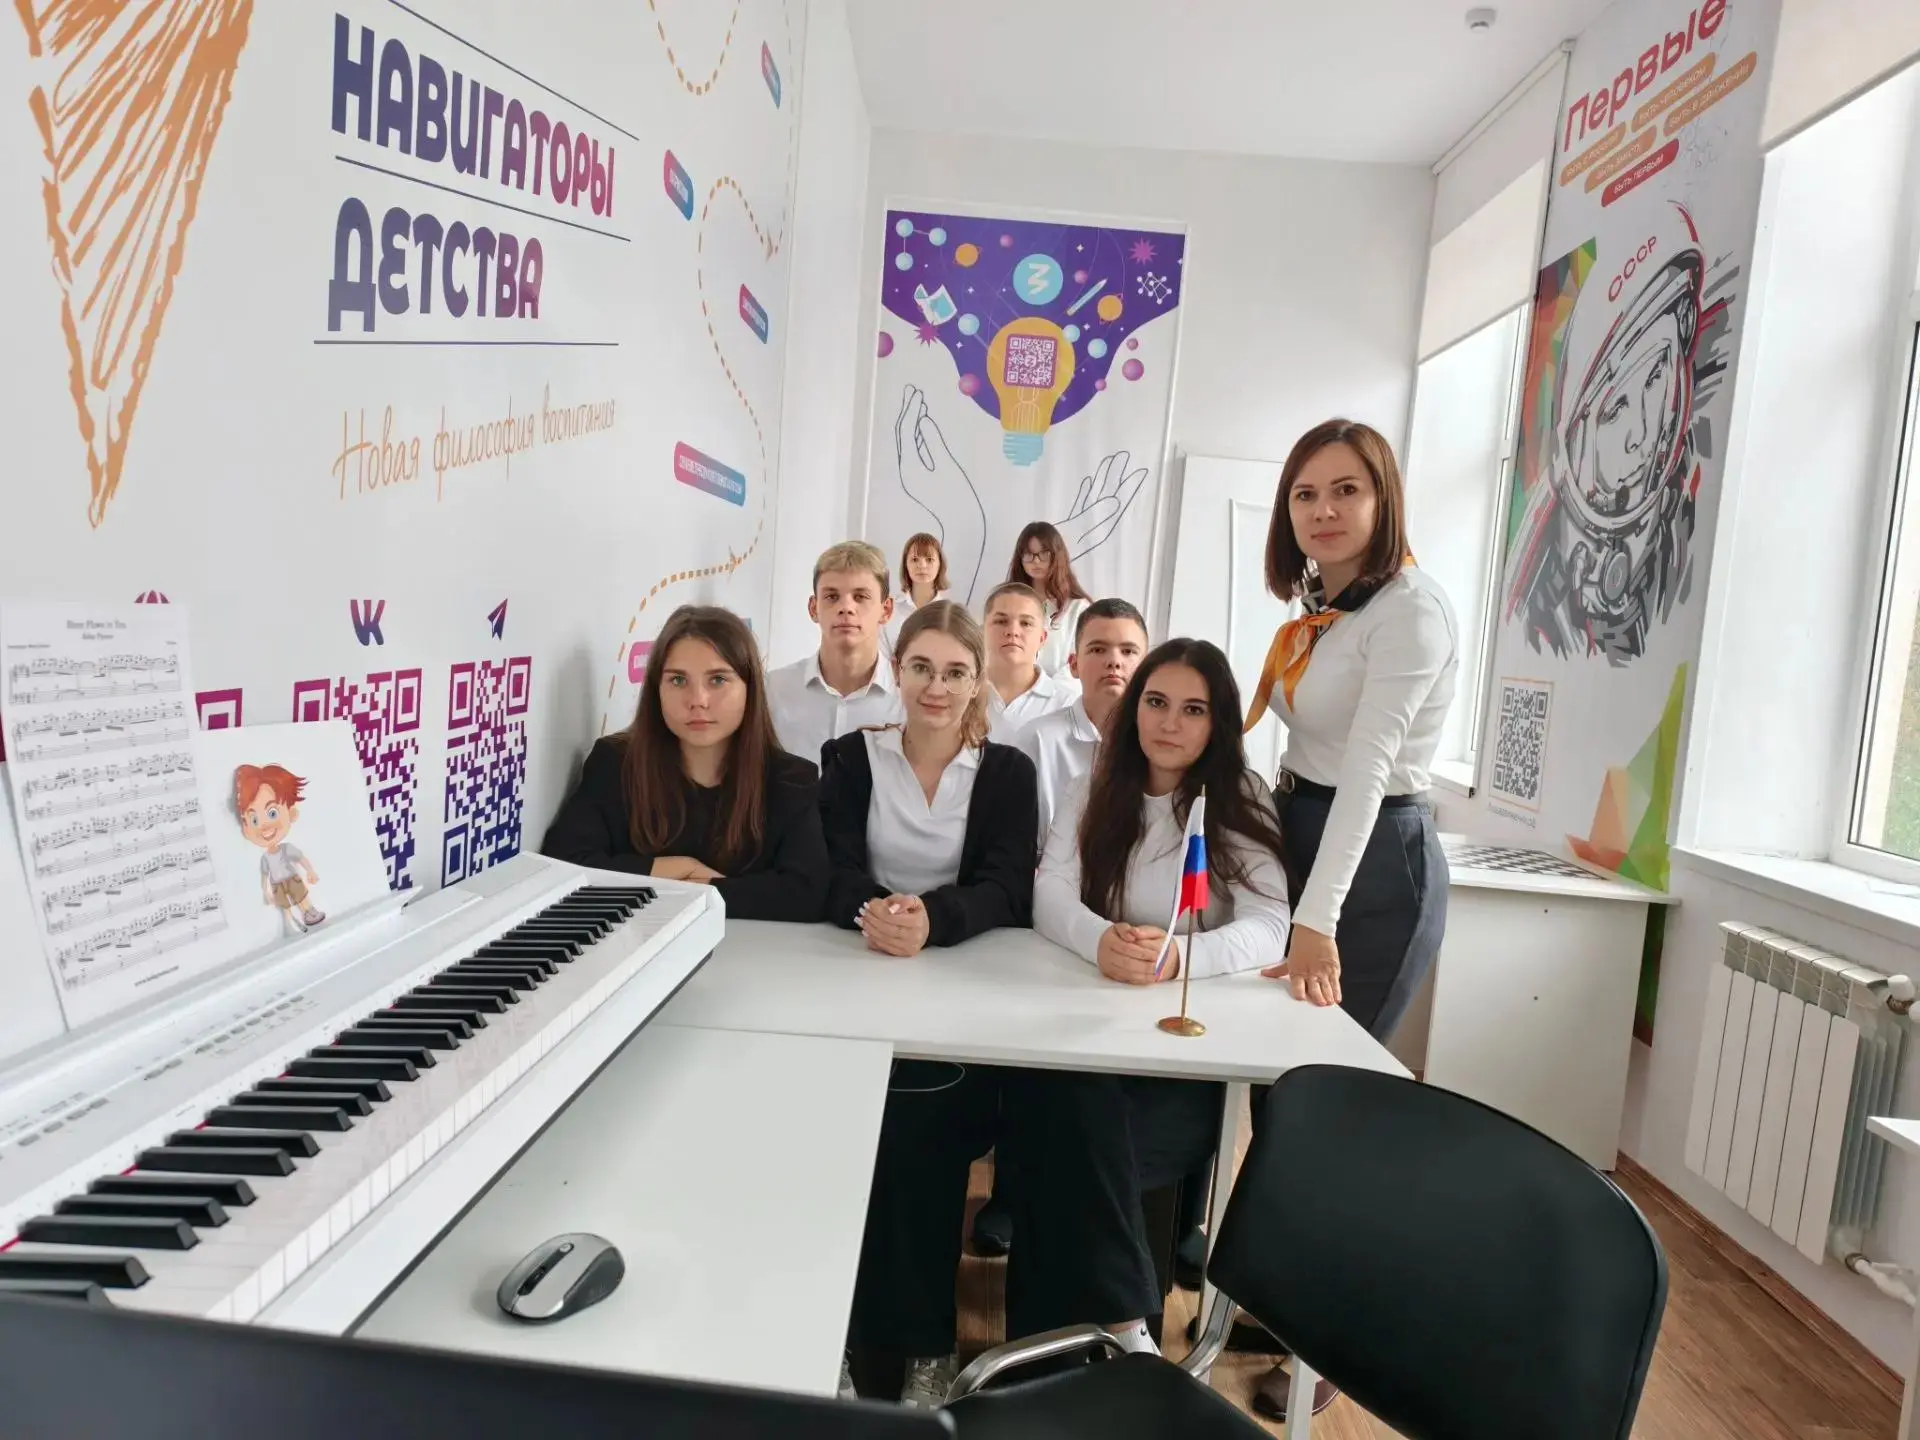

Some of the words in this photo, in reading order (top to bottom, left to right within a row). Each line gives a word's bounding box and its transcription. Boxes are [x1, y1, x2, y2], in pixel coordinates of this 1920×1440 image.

[332, 12, 615, 218] НАВИГАТОРЫ
[328, 197, 544, 332] ДЕТСТВА
[1608, 235, 1657, 303] СССР
[332, 404, 421, 500] Новая
[433, 391, 535, 503] философия
[541, 380, 616, 444] воспитания
